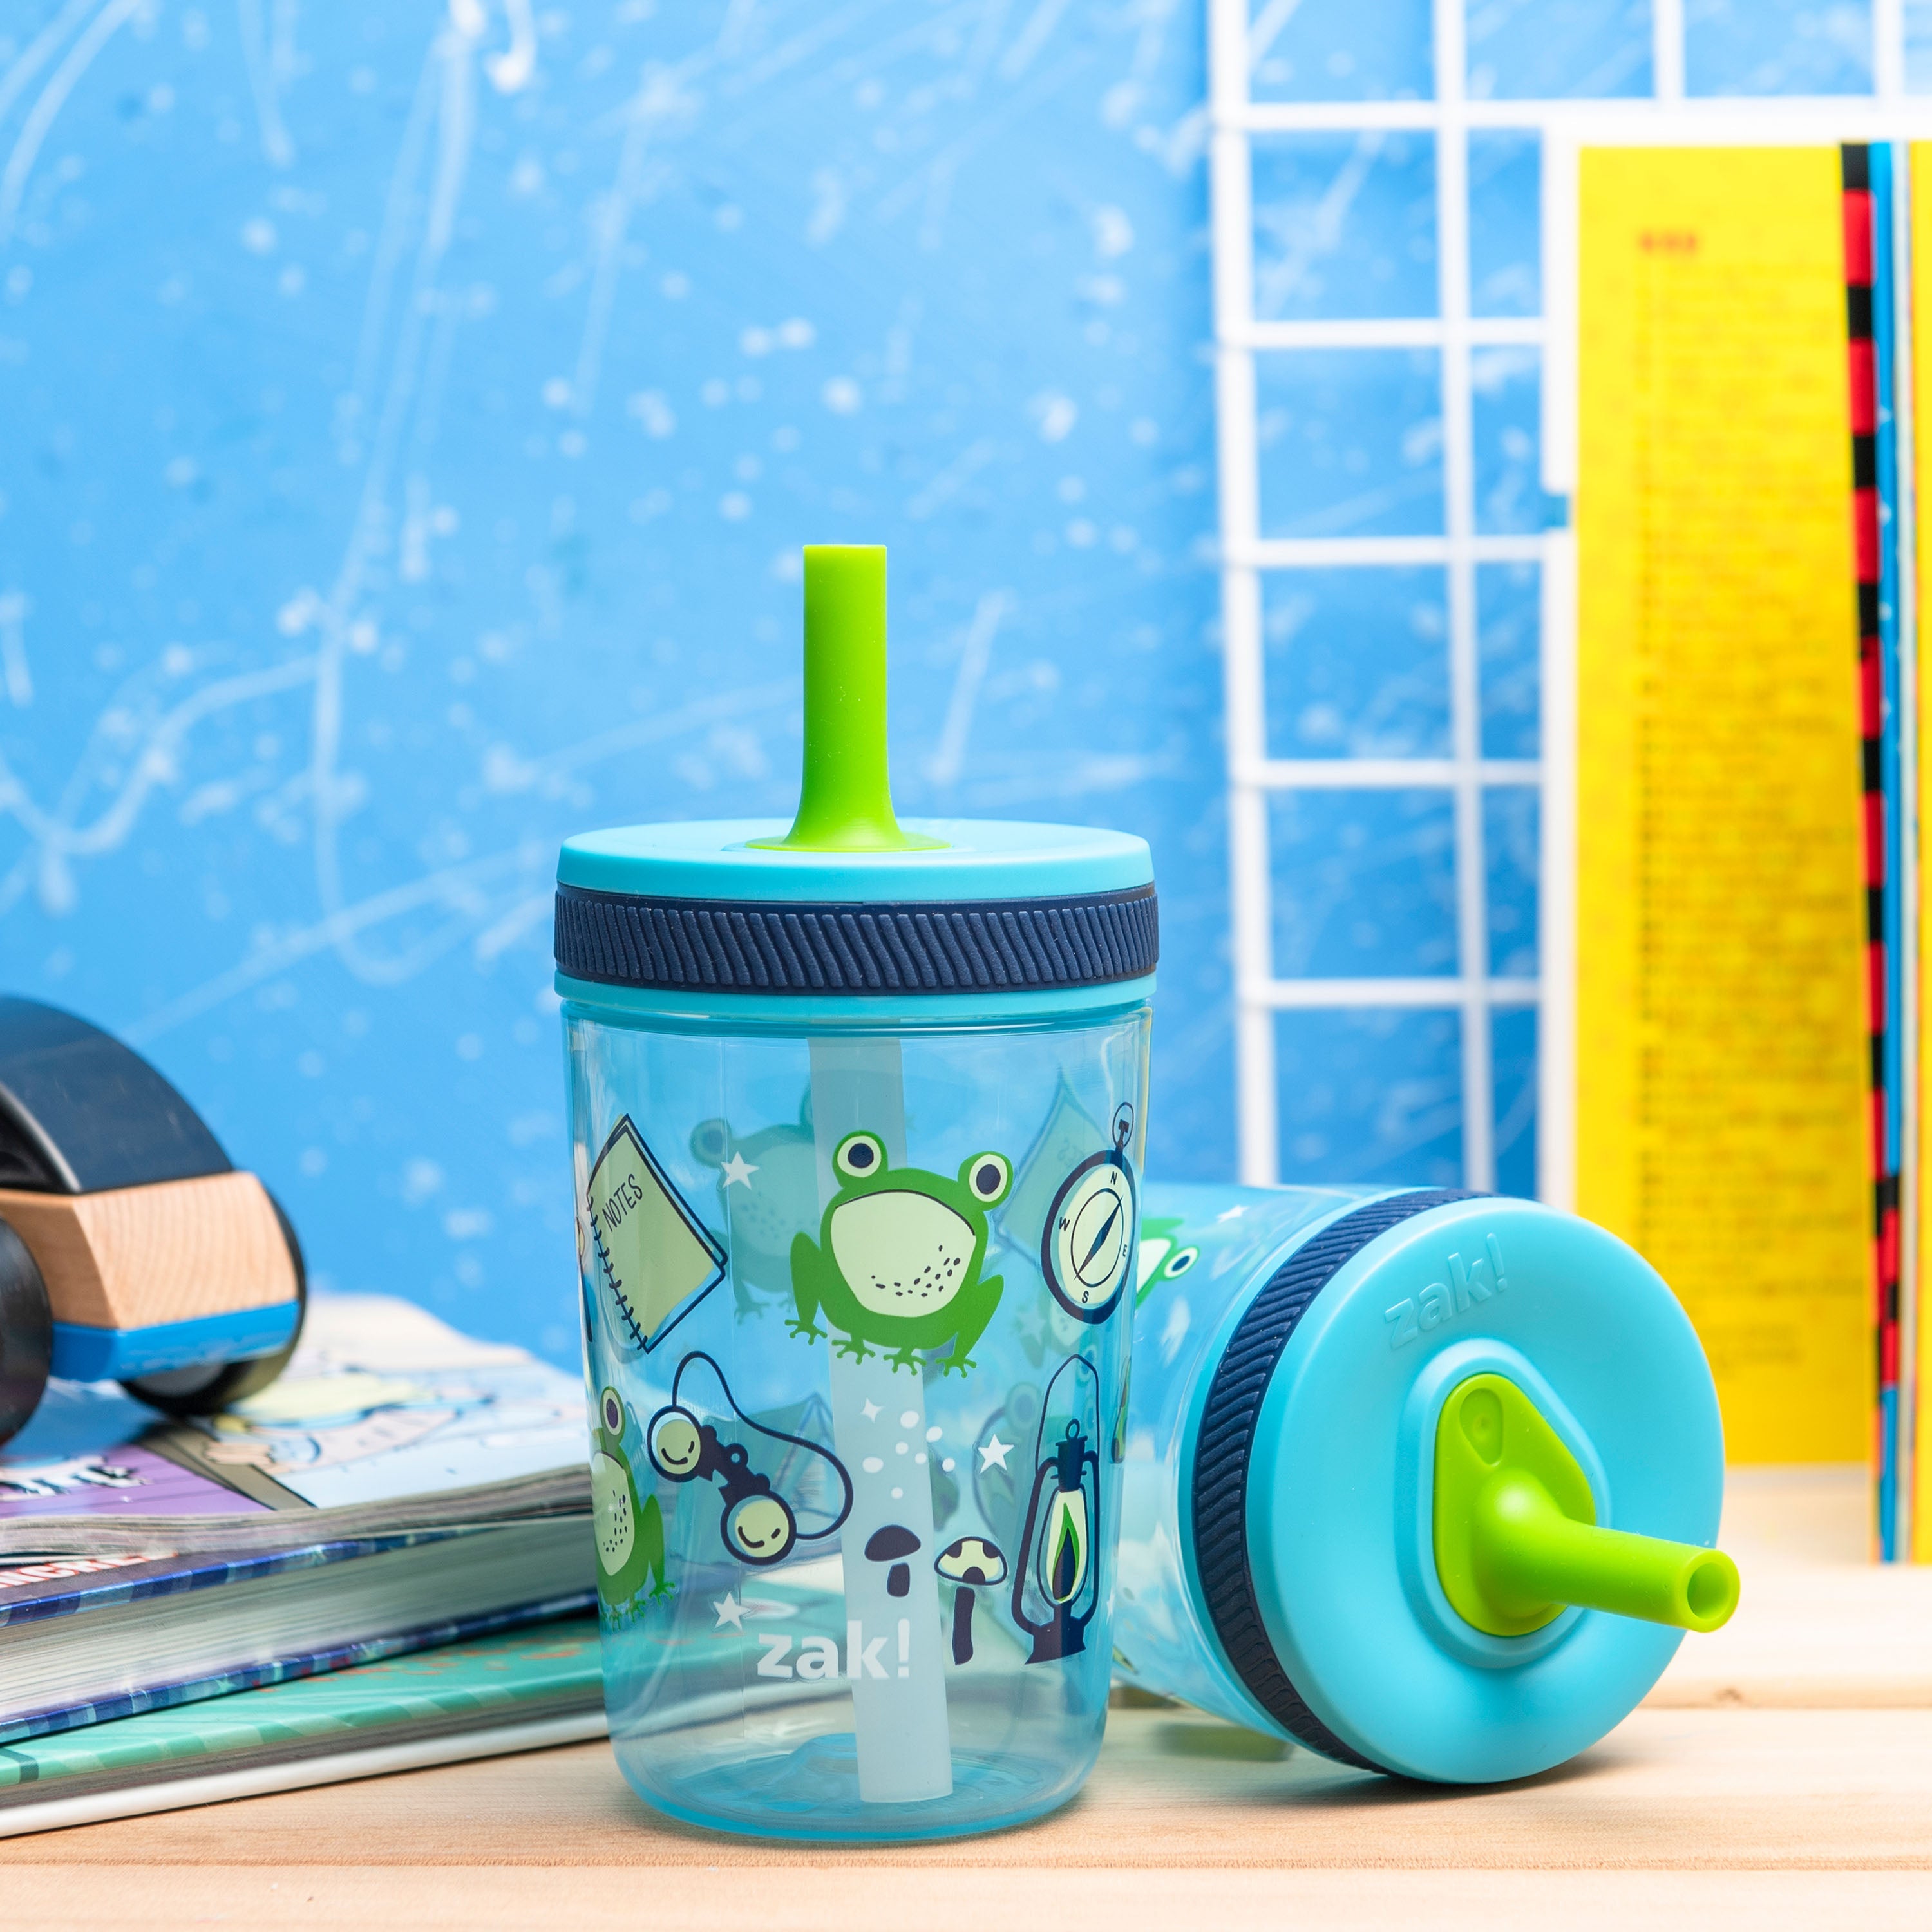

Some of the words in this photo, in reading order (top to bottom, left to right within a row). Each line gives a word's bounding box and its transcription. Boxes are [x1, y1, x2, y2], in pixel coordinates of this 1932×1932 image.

[1110, 1171, 1117, 1186] N
[602, 1173, 643, 1232] NOTES
[1059, 1216, 1070, 1231] W
[1122, 1244, 1128, 1258] E
[1081, 1290, 1089, 1303] S
[1385, 1232, 1508, 1351] zak!
[757, 1618, 911, 1681] zak!
